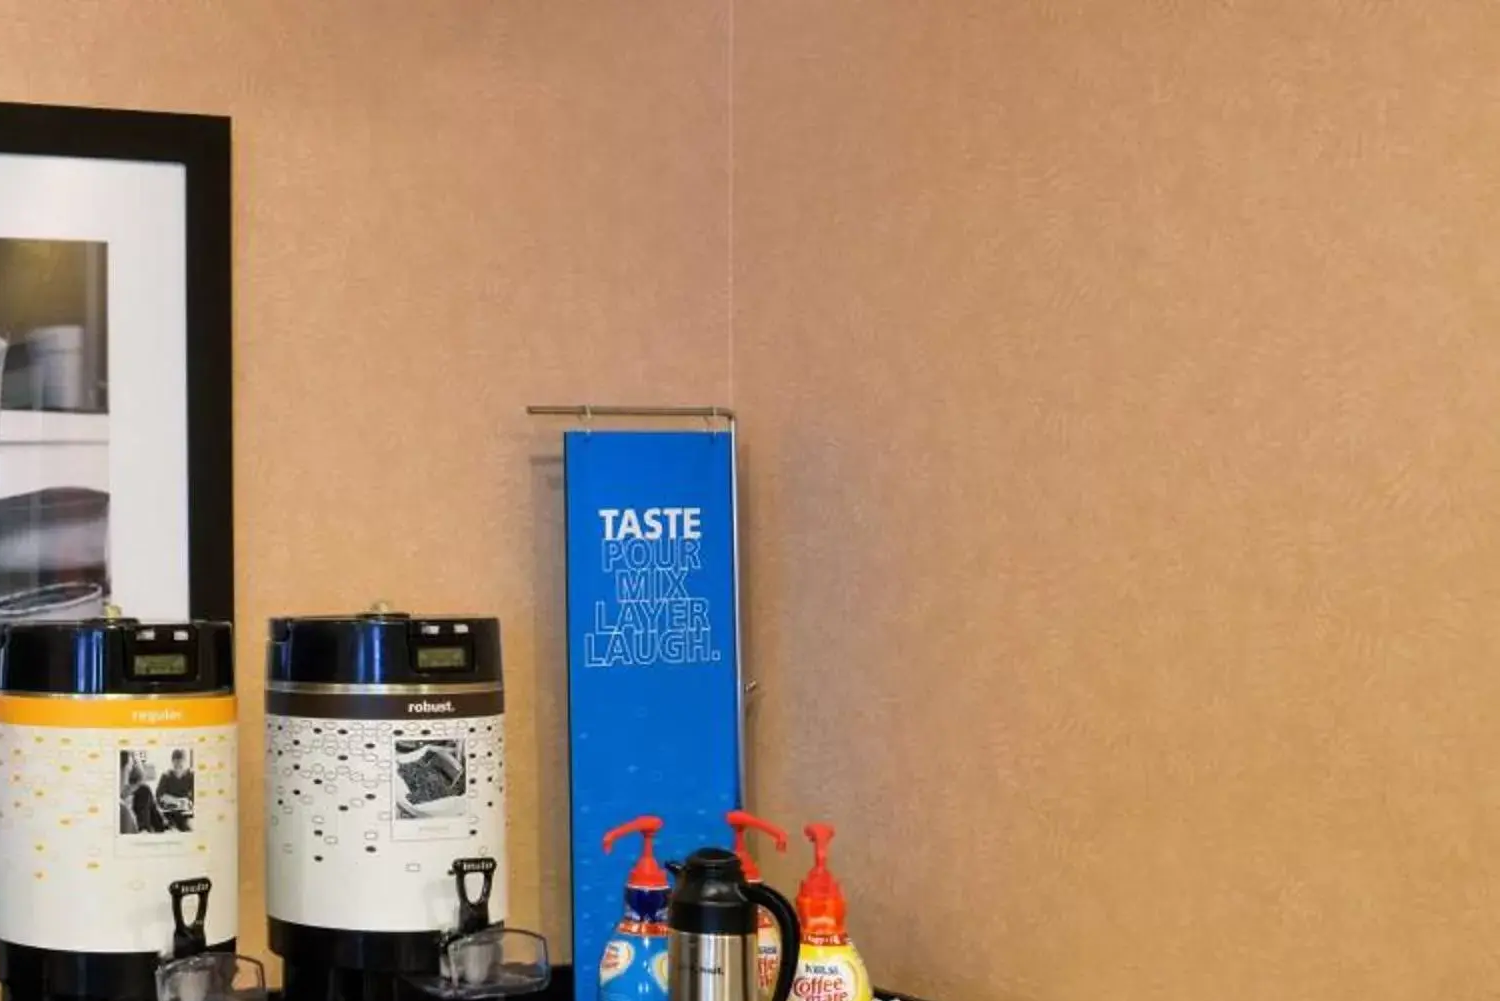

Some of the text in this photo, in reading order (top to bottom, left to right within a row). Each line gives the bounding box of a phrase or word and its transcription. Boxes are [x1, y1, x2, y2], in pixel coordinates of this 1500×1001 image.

[599, 507, 702, 541] TASTE
[602, 537, 702, 573] POUR
[616, 567, 689, 603] MIX
[595, 597, 712, 635] LAYER
[584, 630, 722, 668] LAUGH.
[793, 976, 844, 997] Coffee
